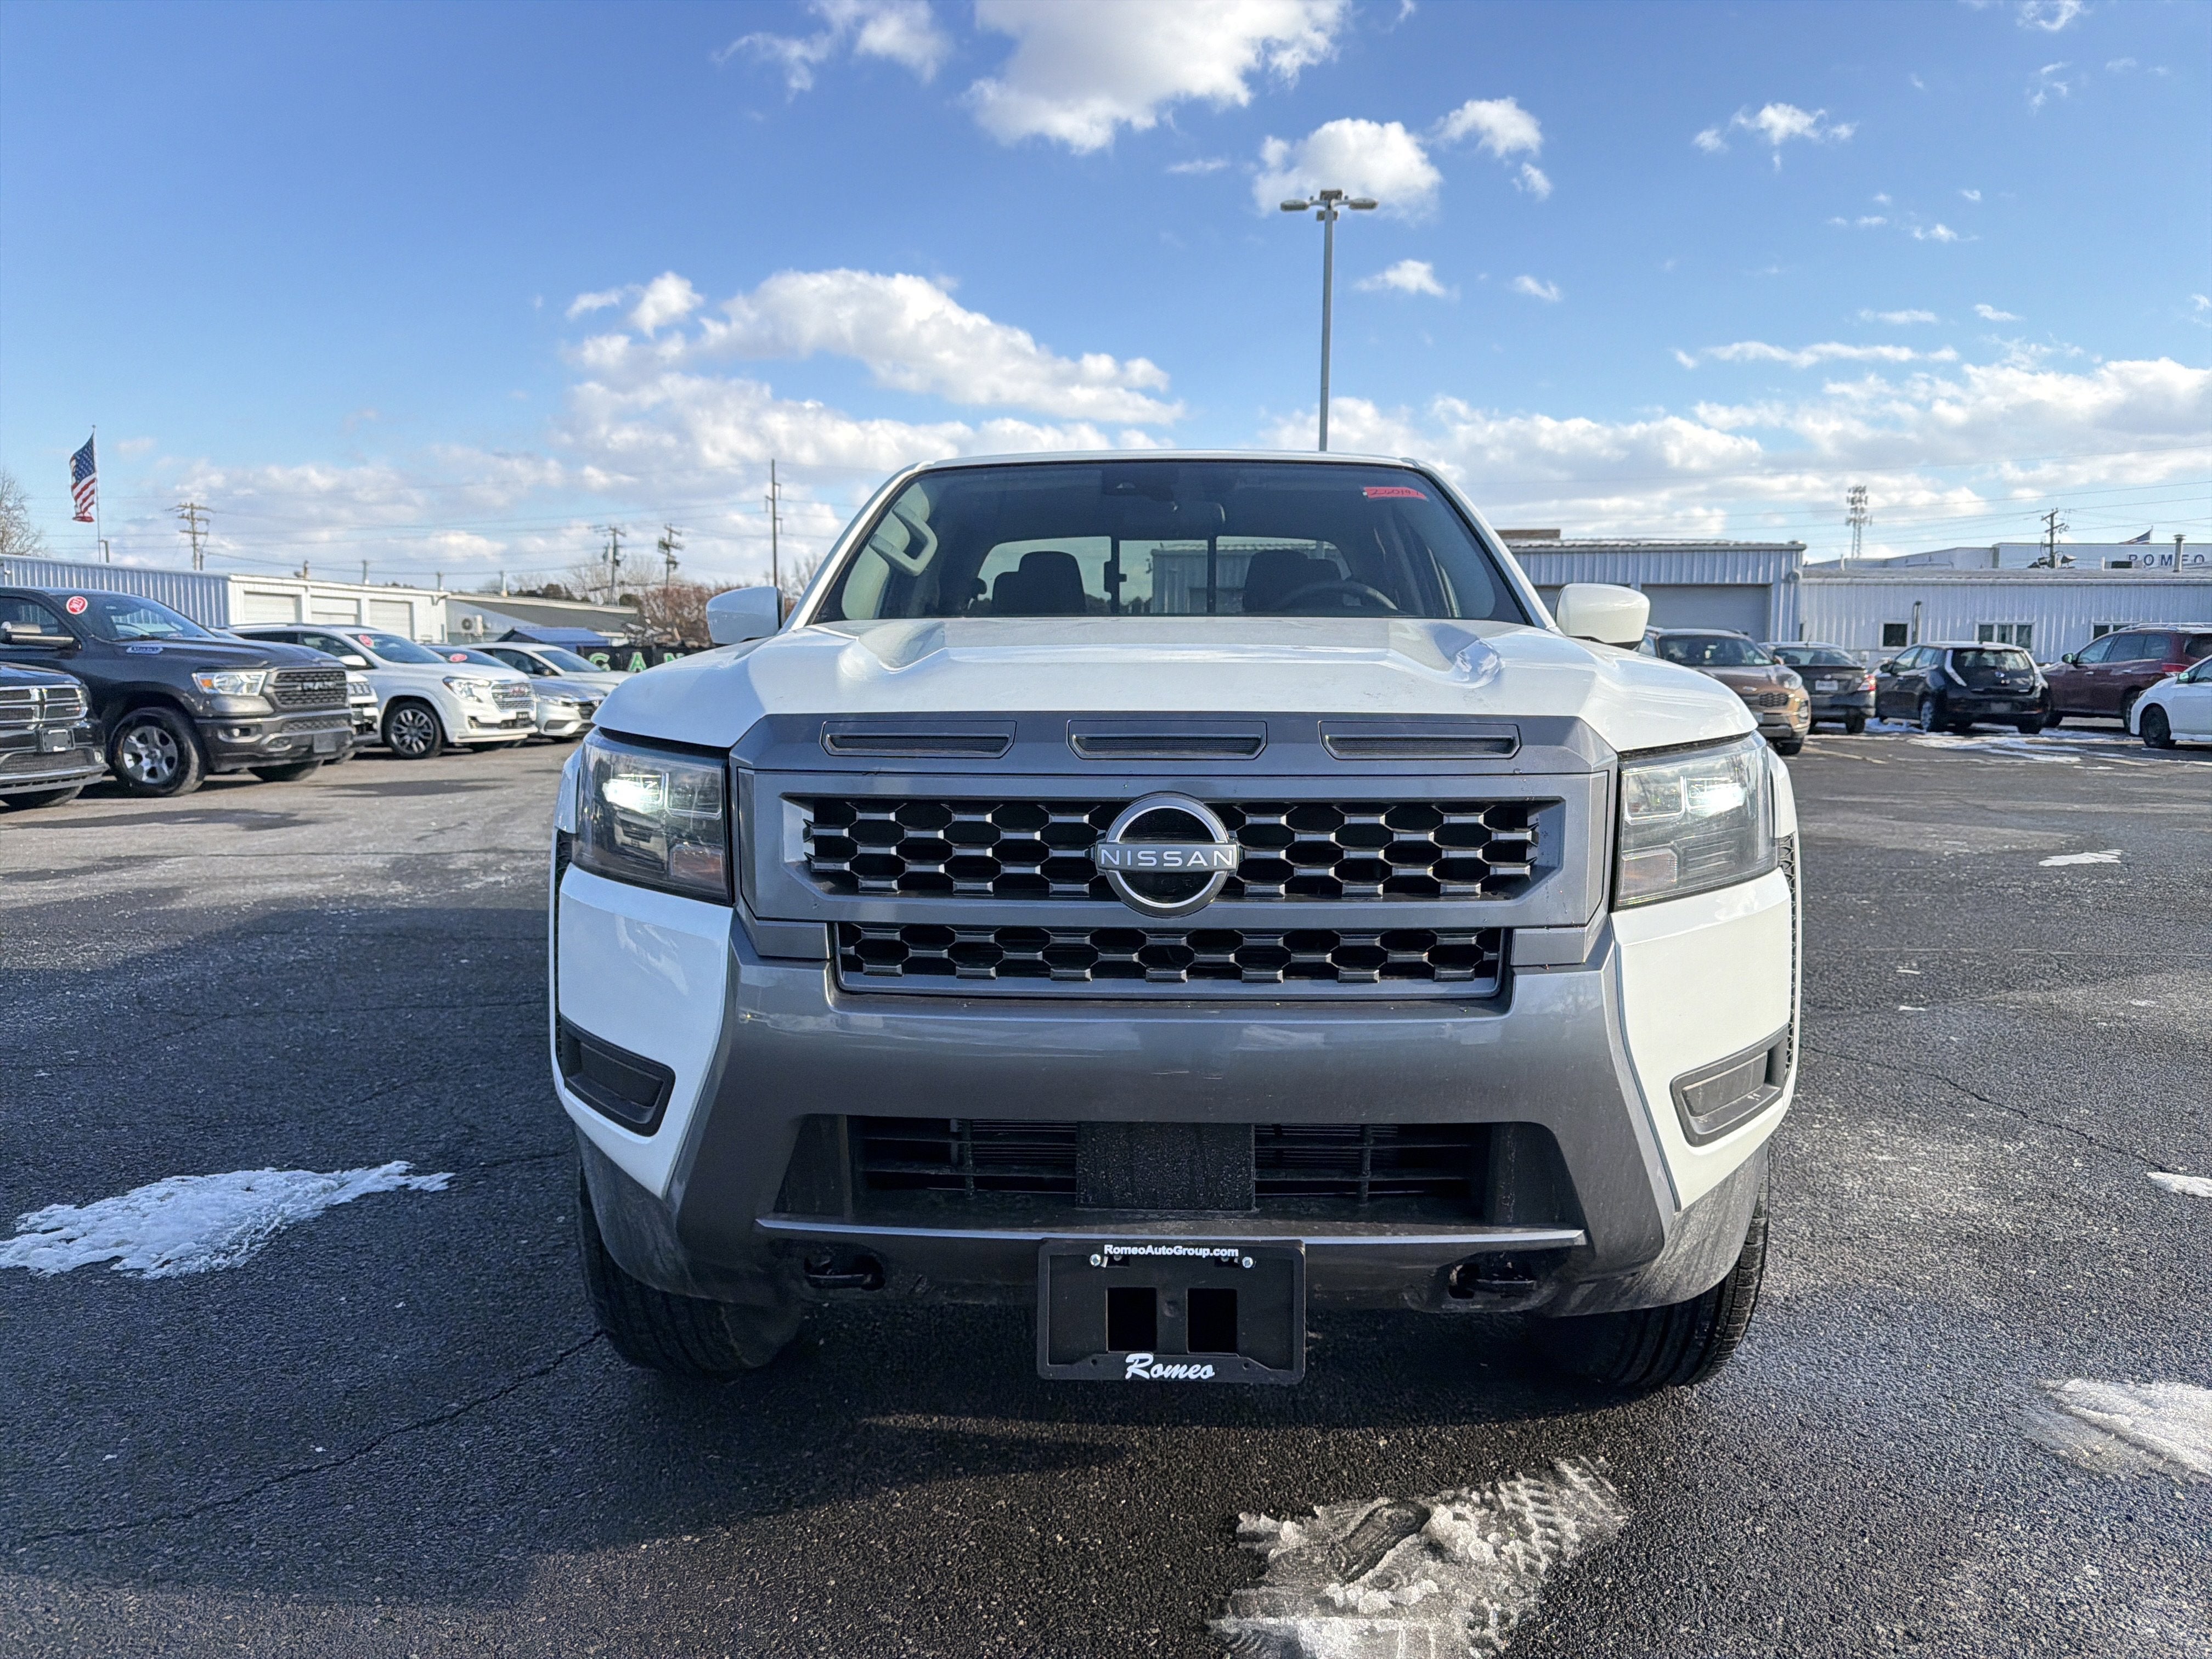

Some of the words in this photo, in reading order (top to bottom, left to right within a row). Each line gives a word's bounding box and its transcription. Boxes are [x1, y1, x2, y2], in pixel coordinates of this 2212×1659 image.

[1101, 849, 1233, 867] NISSAN
[1104, 1244, 1239, 1258] RomeoAutoGroup.com
[1125, 1352, 1215, 1380] Romeo
